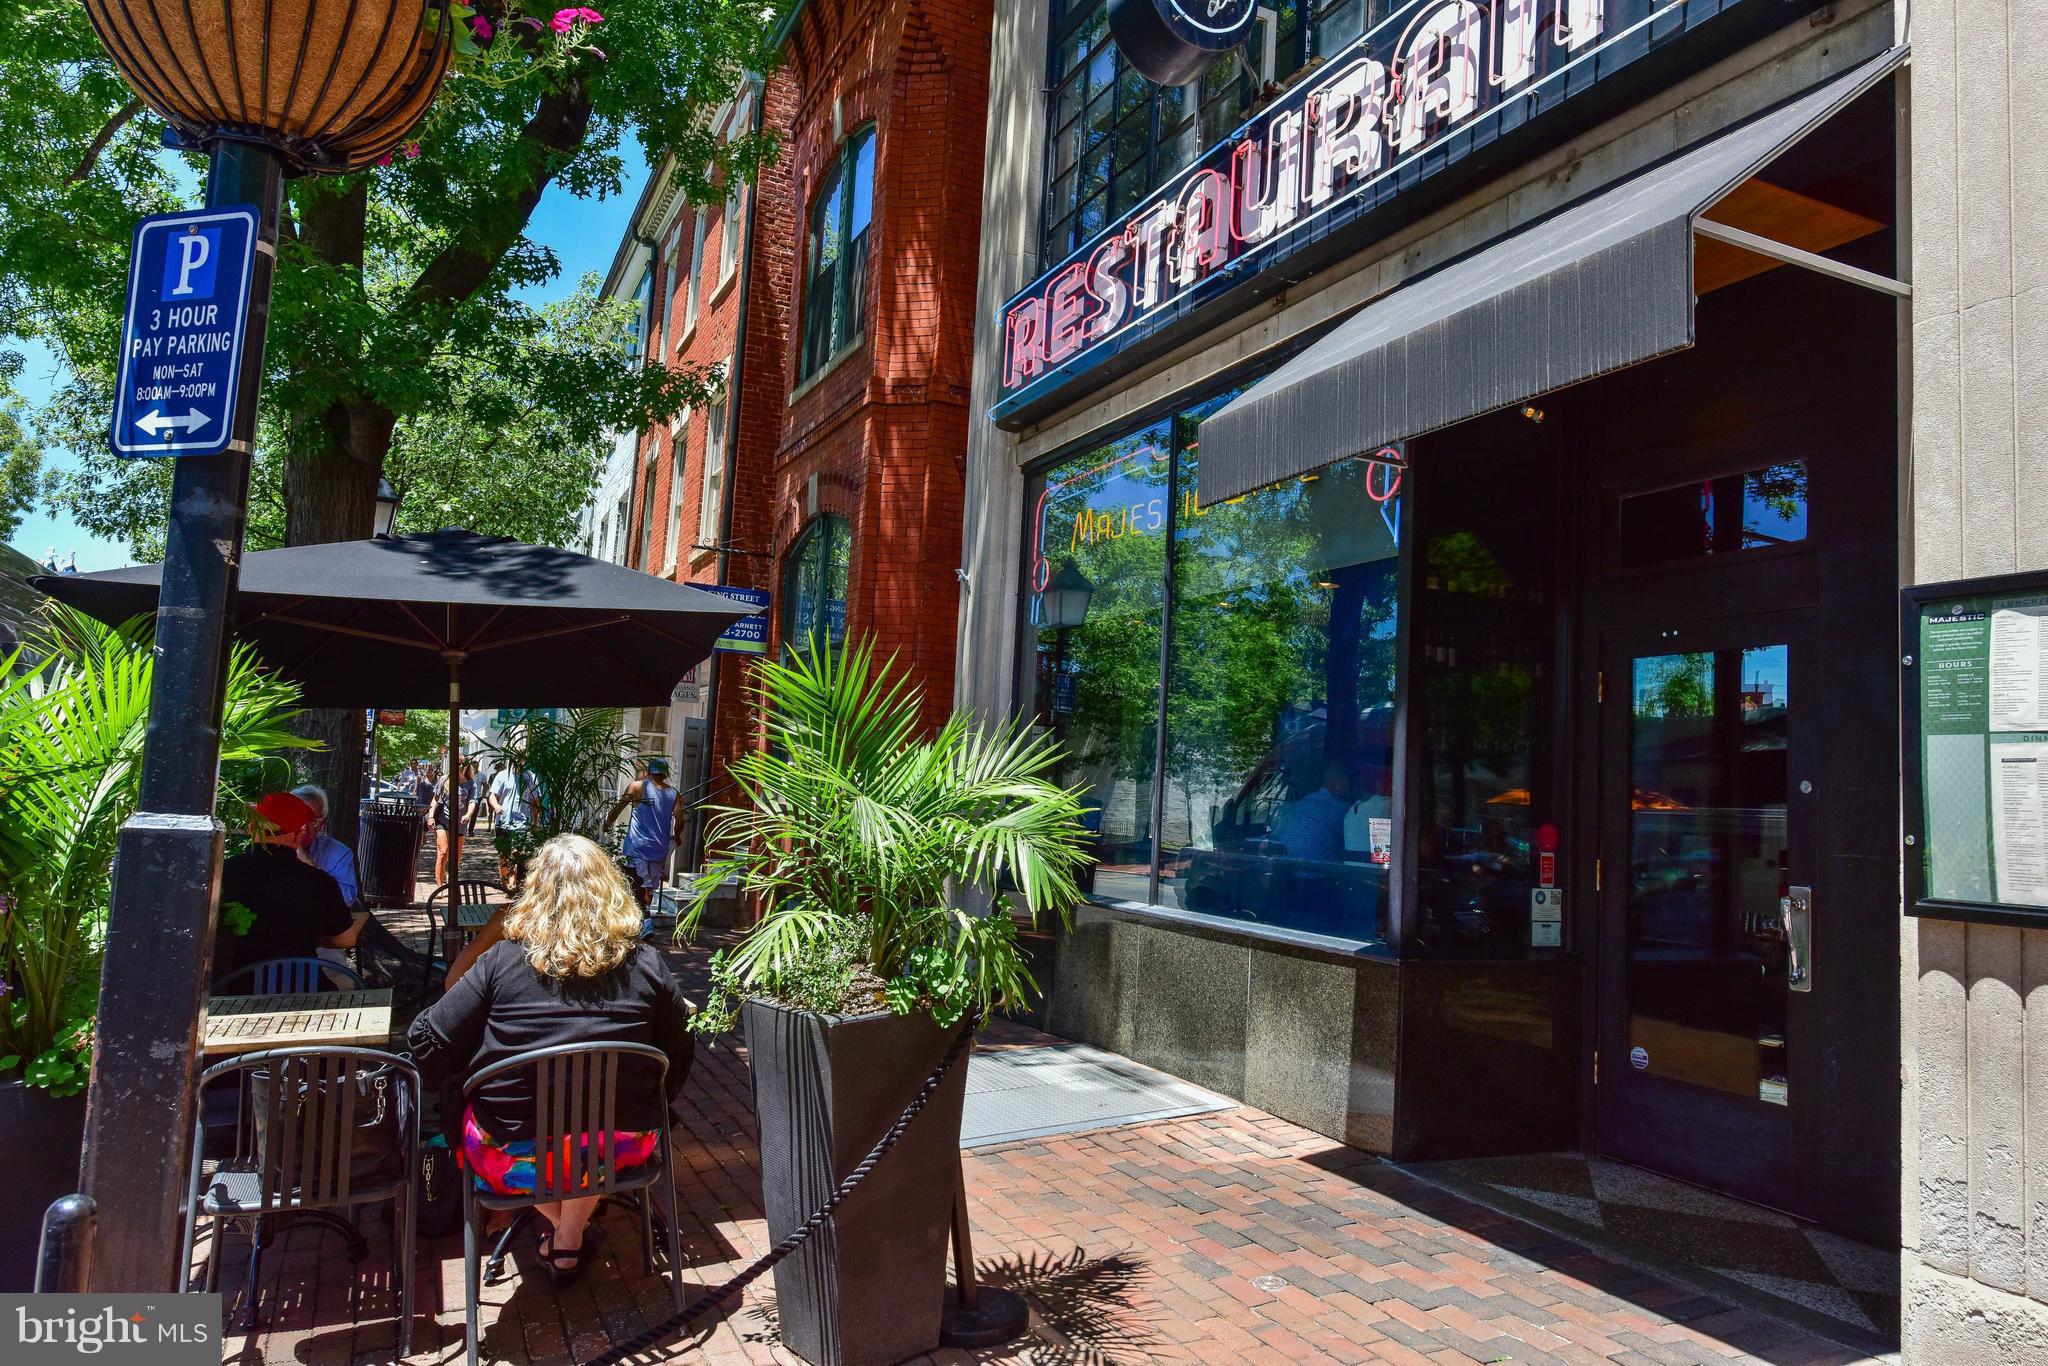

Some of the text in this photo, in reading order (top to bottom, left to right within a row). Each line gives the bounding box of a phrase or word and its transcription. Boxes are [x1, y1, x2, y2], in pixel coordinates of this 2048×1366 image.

[172, 235, 210, 296] P
[150, 304, 217, 331] 3 HOUR
[132, 331, 231, 359] PAY PARKING
[730, 592, 761, 603] STREET
[1928, 613, 1985, 624] MAJESTIC
[734, 622, 763, 631] ARNETT
[1938, 660, 1973, 669] HOURS
